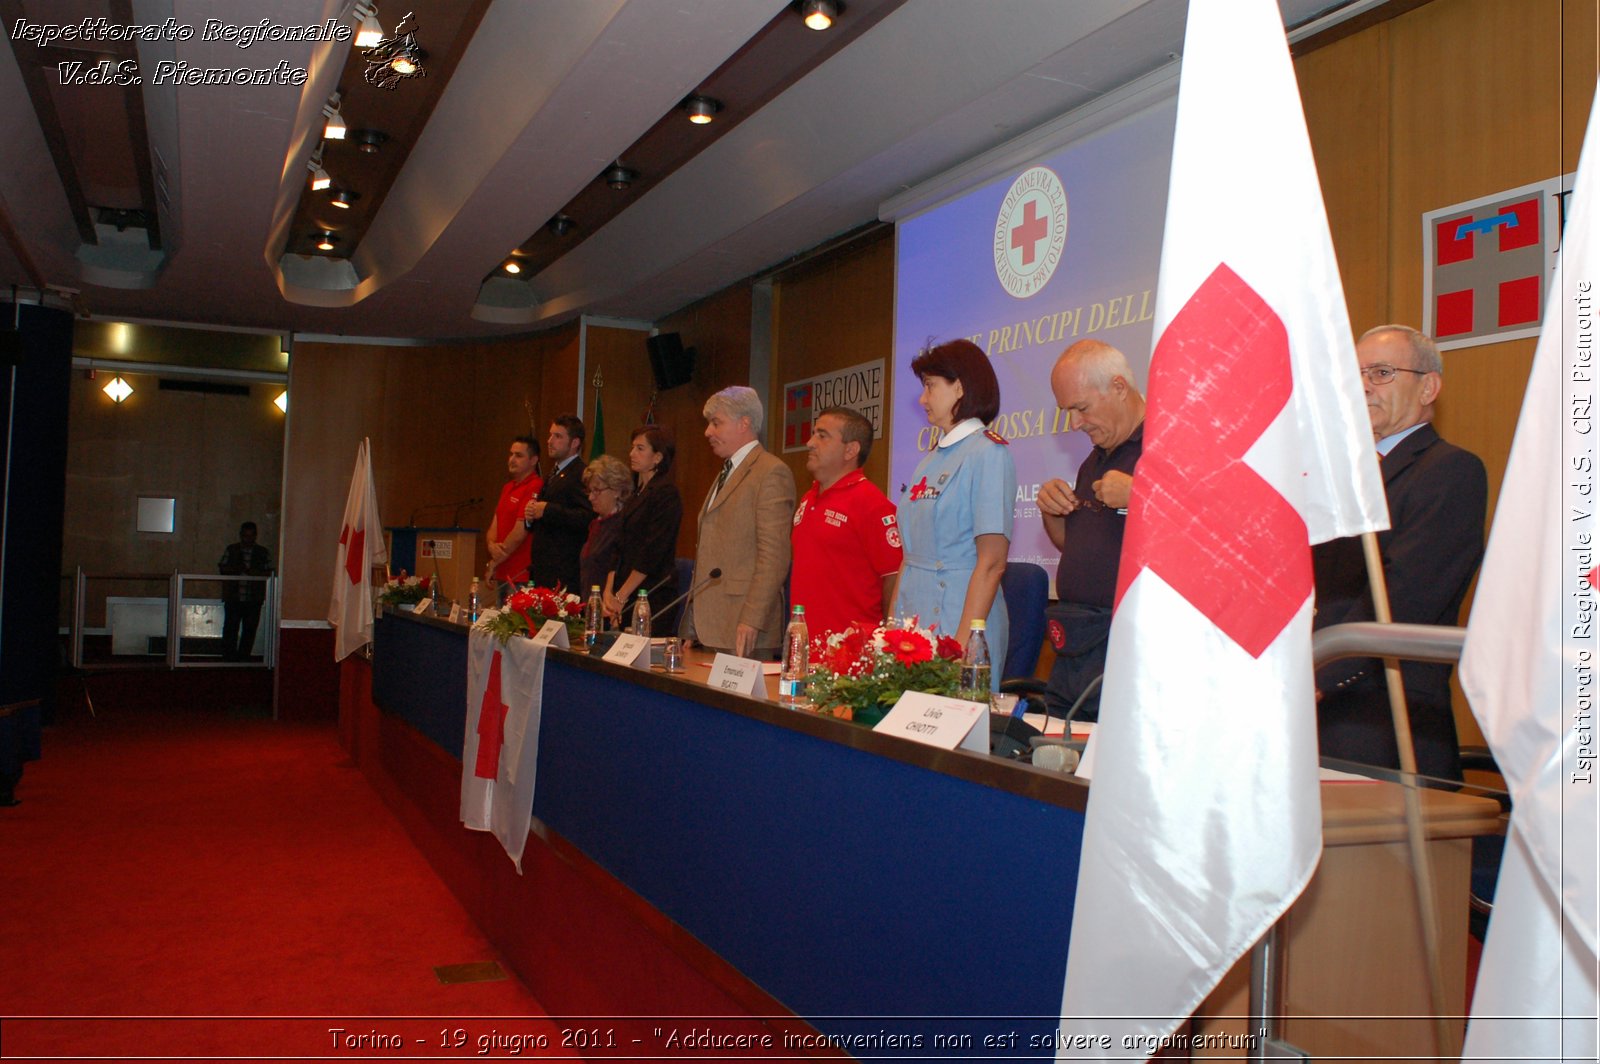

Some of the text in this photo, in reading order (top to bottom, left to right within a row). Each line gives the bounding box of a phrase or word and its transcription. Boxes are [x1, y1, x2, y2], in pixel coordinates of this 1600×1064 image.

[1015, 171, 1053, 196] GINEVRA
[1050, 186, 1062, 204] 22
[1006, 191, 1017, 209] DI
[1048, 203, 1066, 264] AGOSTO
[996, 210, 1023, 293] CONVENZIONE
[986, 307, 1083, 356] PRINCIPI
[1087, 290, 1154, 333] DELL
[814, 367, 880, 411] REGIONE
[991, 409, 1045, 440] OSSA
[923, 707, 943, 719] Livio
[905, 721, 939, 736] CHIOTTI
